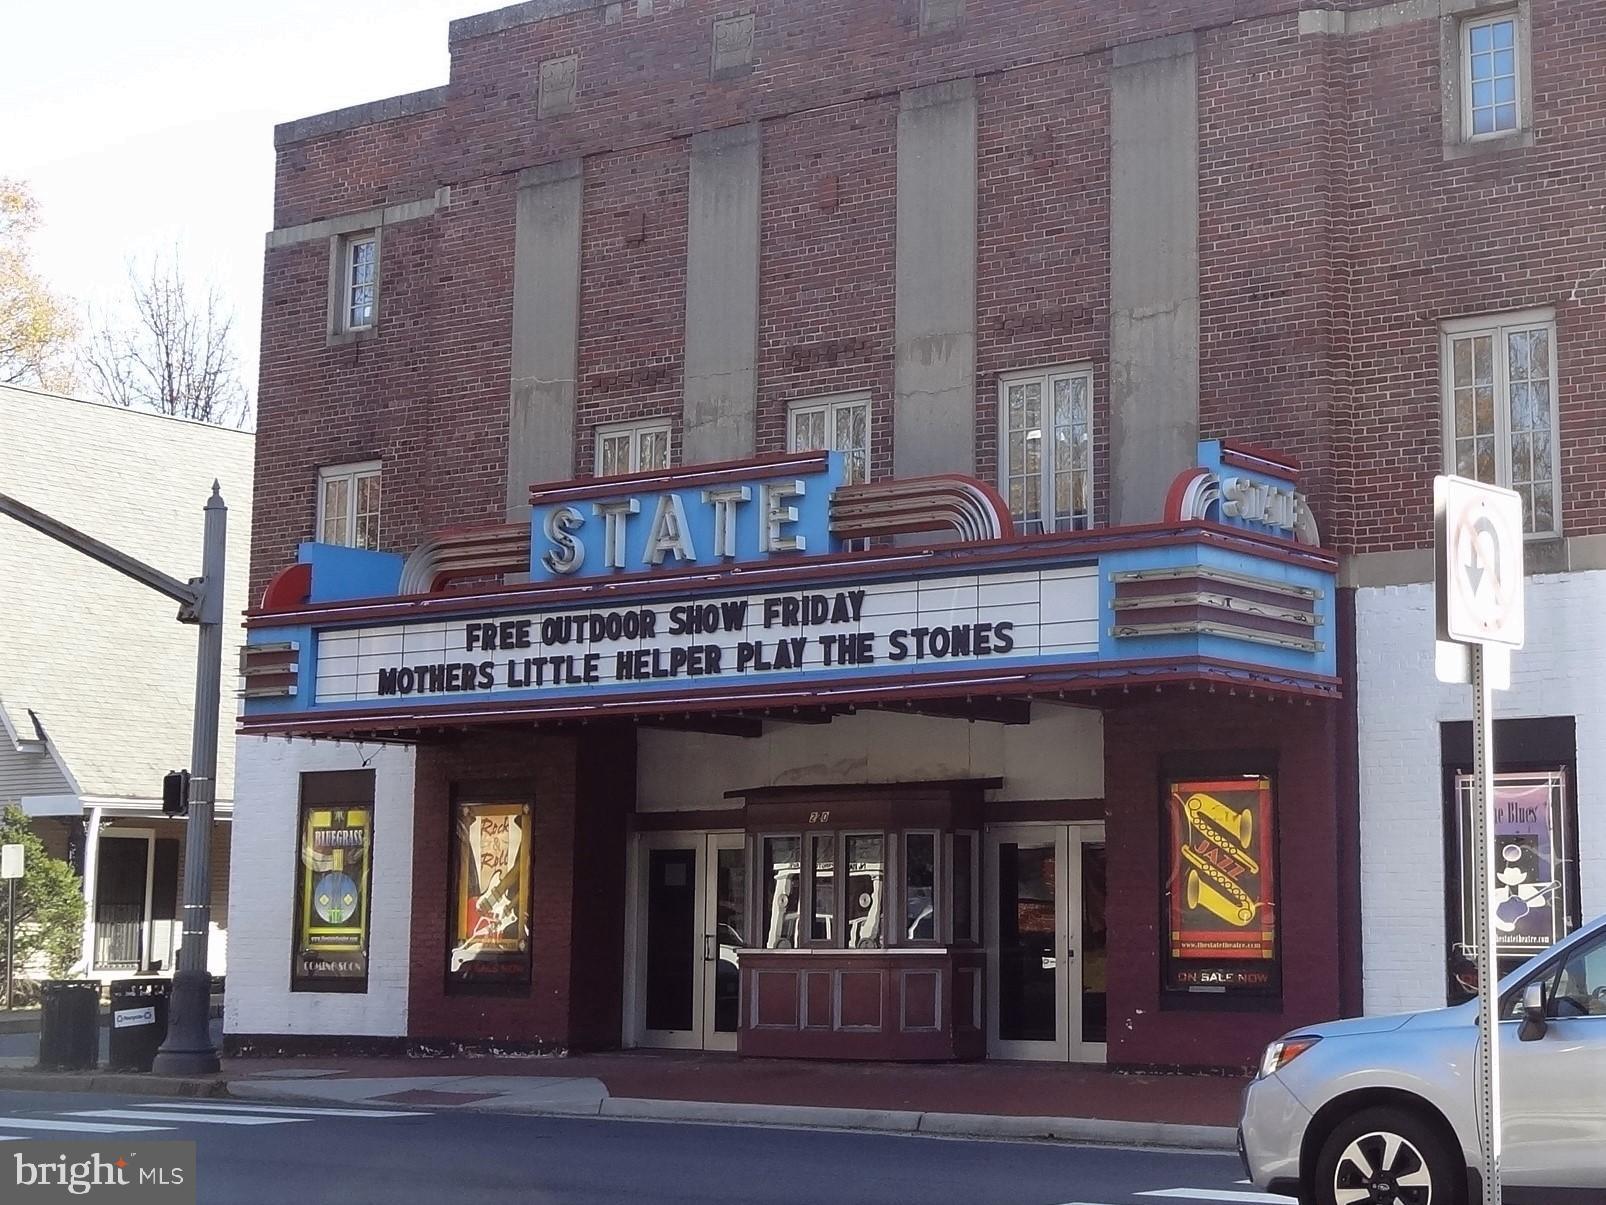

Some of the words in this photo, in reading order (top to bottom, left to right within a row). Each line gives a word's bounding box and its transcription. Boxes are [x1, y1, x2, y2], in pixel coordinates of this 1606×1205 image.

[540, 479, 806, 575] STATE
[466, 619, 532, 652] FREE
[541, 609, 656, 646] OUTDOOR
[668, 600, 748, 636] SHOW
[763, 590, 866, 629] FRIDAY
[378, 660, 495, 696] MOTHERS
[507, 653, 601, 688] LITTLE
[615, 644, 723, 681] HELPER
[736, 637, 807, 673] PLAY
[818, 632, 875, 666] THE
[888, 621, 1014, 661] STONES
[314, 829, 363, 846] BLUEGRASS
[480, 816, 509, 839] Rock
[480, 849, 509, 870] Roll
[1193, 840, 1246, 880] JAZZ
[1178, 972, 1197, 982] ON
[1200, 972, 1234, 982] SALE
[1238, 973, 1269, 983] NOW
